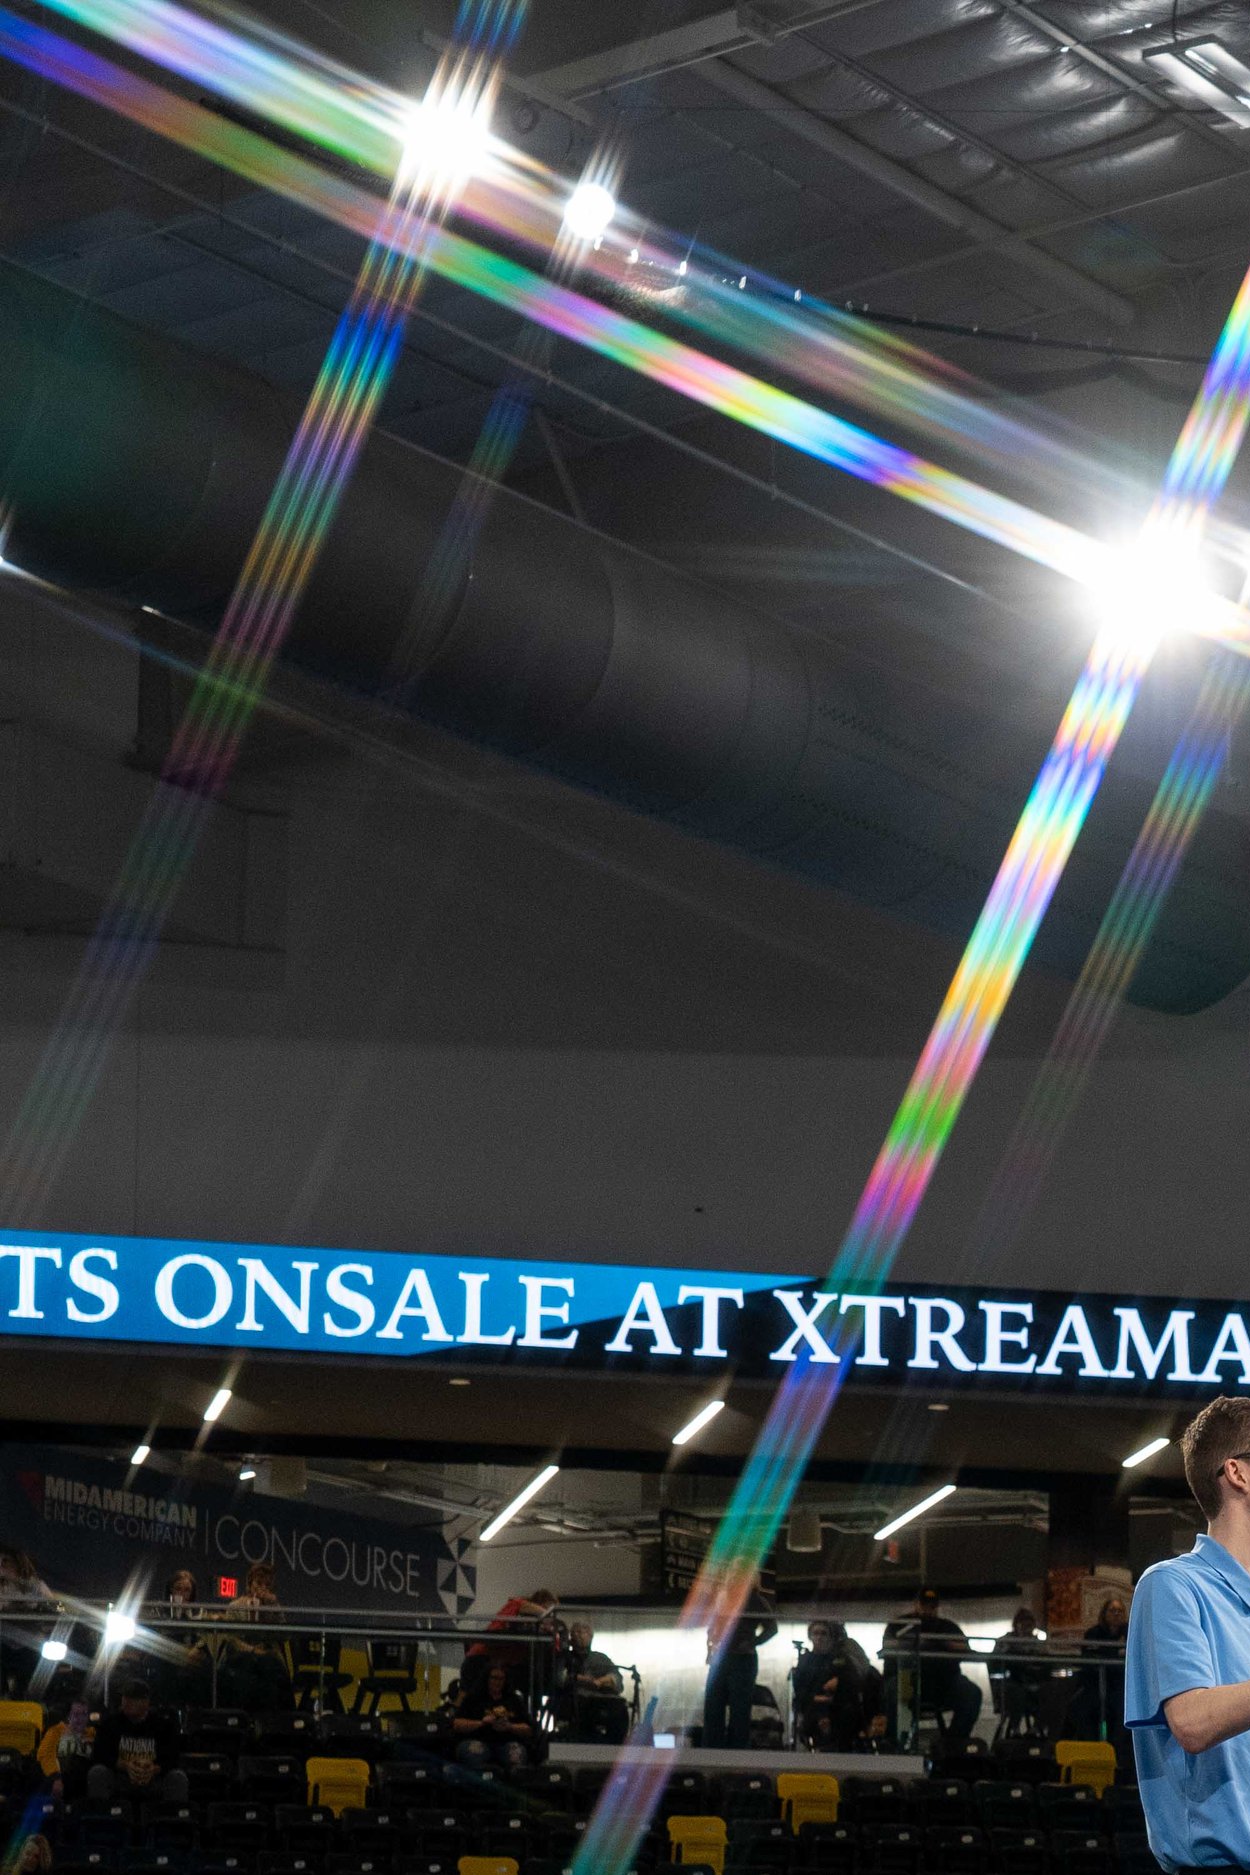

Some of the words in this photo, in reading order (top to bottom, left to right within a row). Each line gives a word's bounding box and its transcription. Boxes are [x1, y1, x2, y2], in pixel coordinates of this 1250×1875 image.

[0, 1245, 119, 1323] TS
[155, 1254, 578, 1349] ONSALE
[605, 1282, 744, 1357] AT
[43, 1474, 198, 1530] MIDAMERICAN
[43, 1500, 111, 1533] ENERGY
[113, 1515, 196, 1549] COMPANY
[214, 1514, 421, 1597] CONCOURSE
[220, 1576, 237, 1598] EXIT
